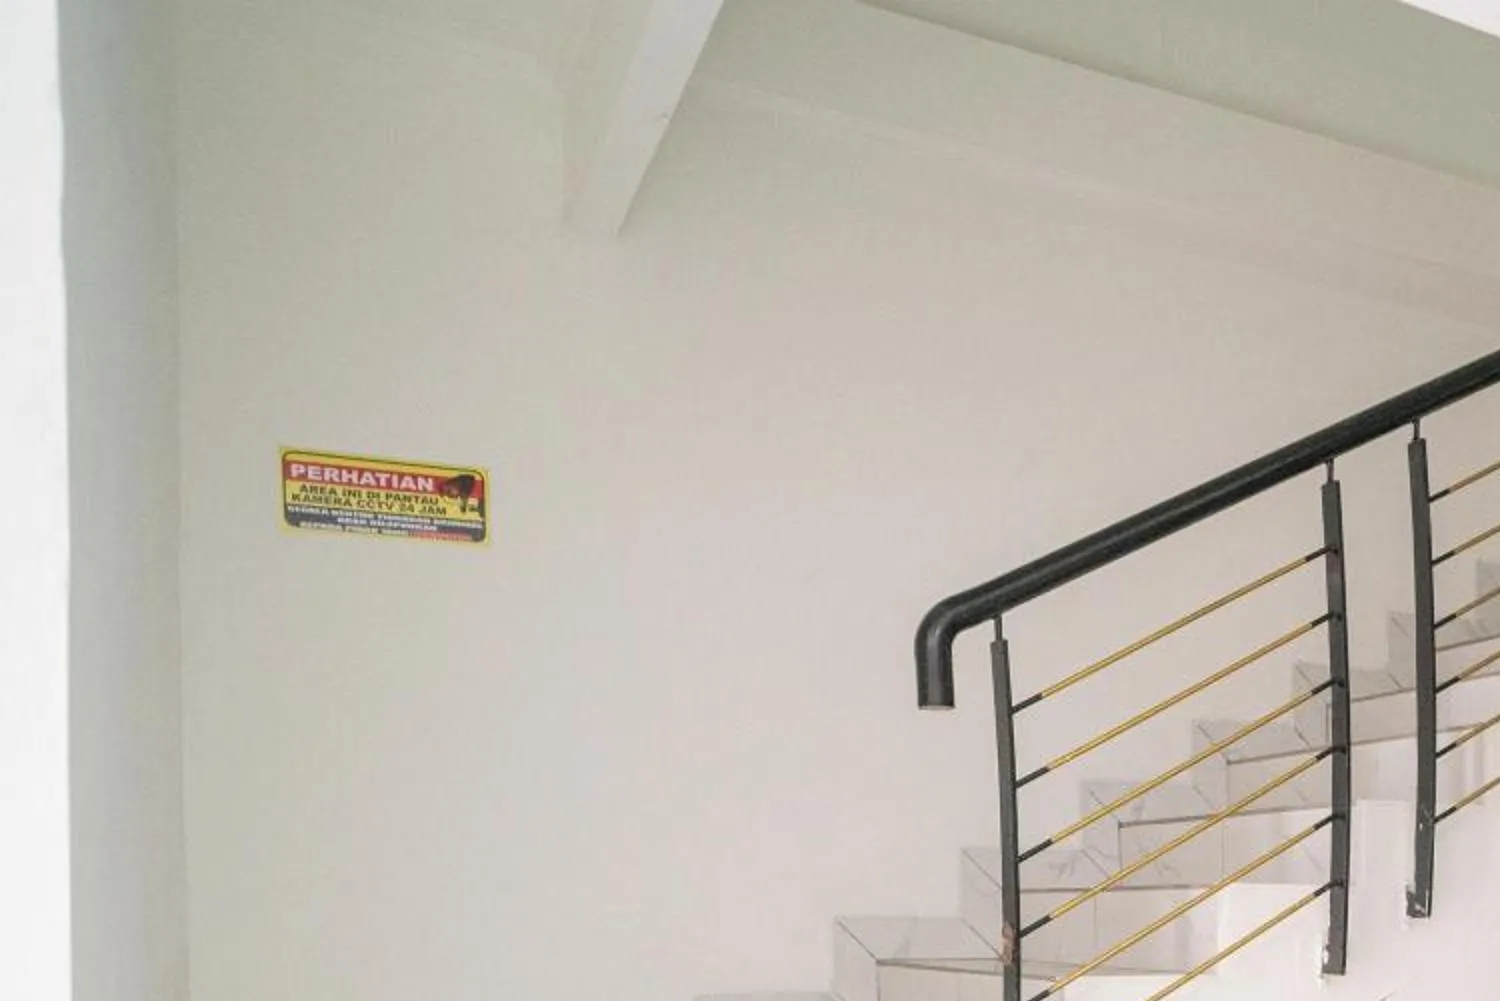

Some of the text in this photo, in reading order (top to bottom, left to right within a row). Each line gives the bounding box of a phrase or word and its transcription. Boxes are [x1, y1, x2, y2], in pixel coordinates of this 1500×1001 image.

[290, 463, 434, 492] PERHATIAN
[291, 493, 447, 516] KAMERA CCTV 24 JAM
[299, 483, 439, 505] AREA INI DI PANTAU
